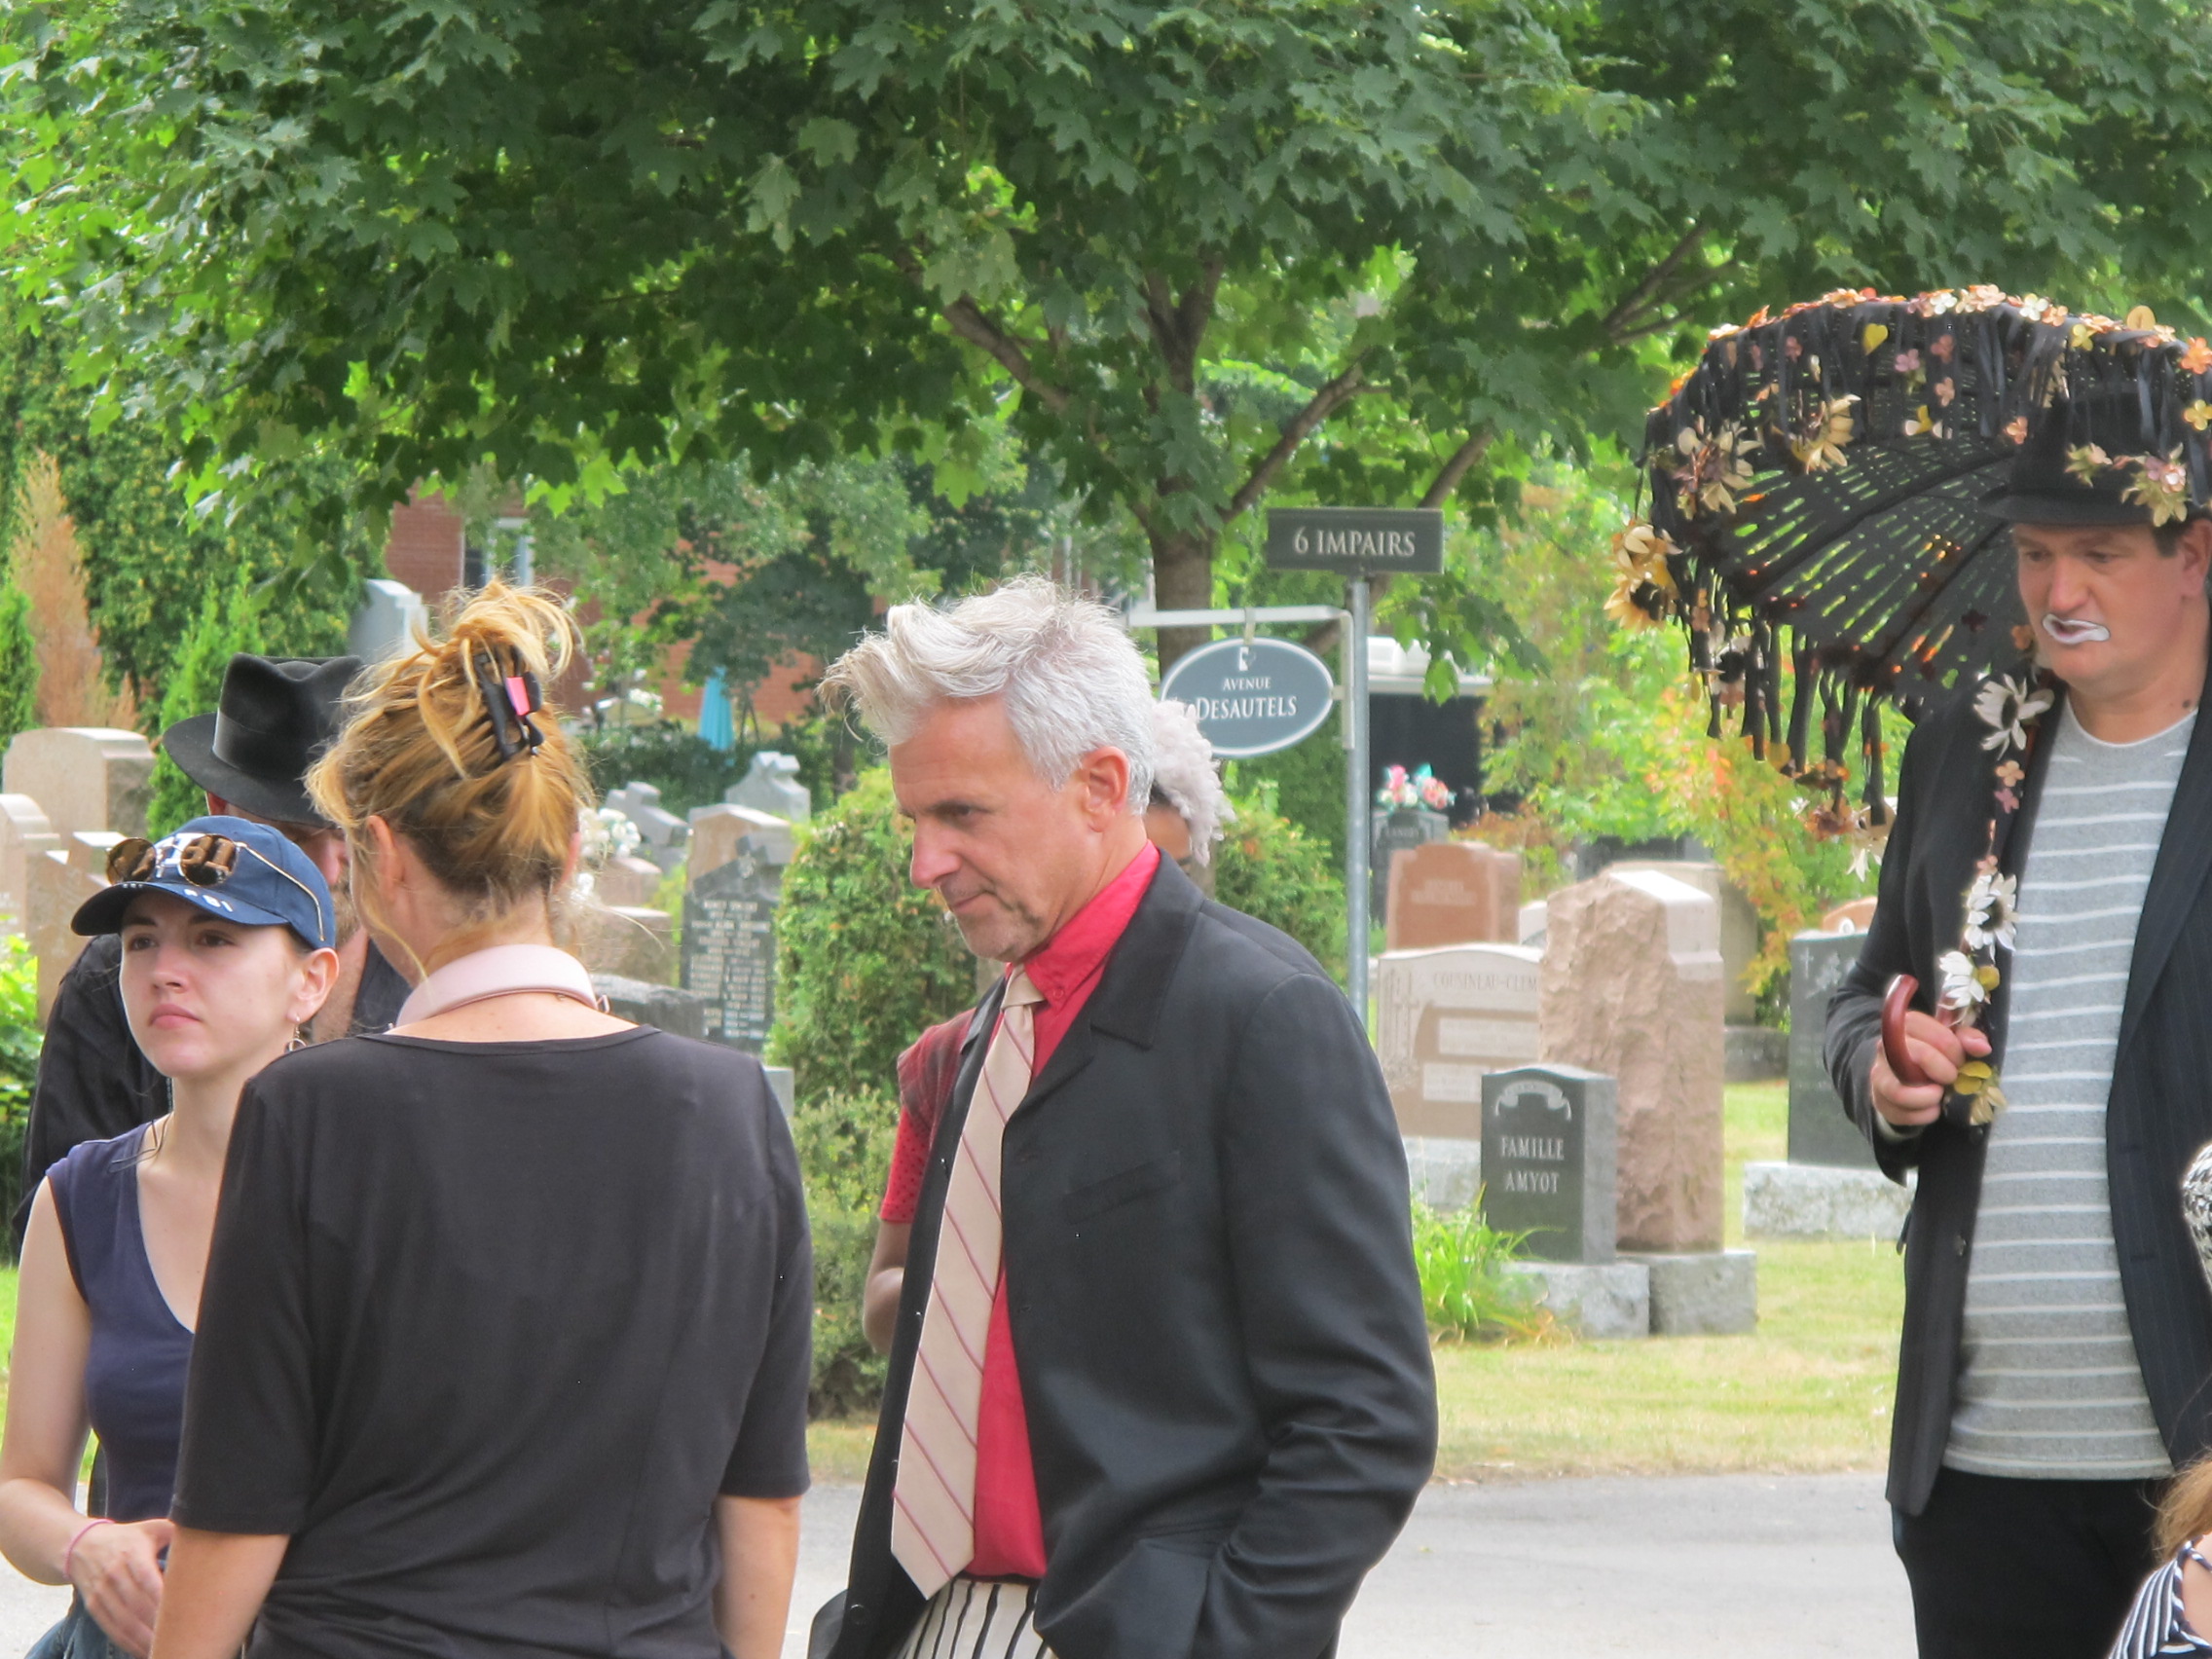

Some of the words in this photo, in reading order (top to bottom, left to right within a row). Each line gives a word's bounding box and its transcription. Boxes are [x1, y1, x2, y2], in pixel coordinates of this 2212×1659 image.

[1294, 527, 1309, 555] 6
[1316, 530, 1417, 557] IMPAIRS
[1222, 677, 1272, 692] AVENUE
[1195, 695, 1298, 720] DESAUTELS
[1499, 1135, 1566, 1161] FAMILLE
[1504, 1171, 1561, 1196] AMYOT
